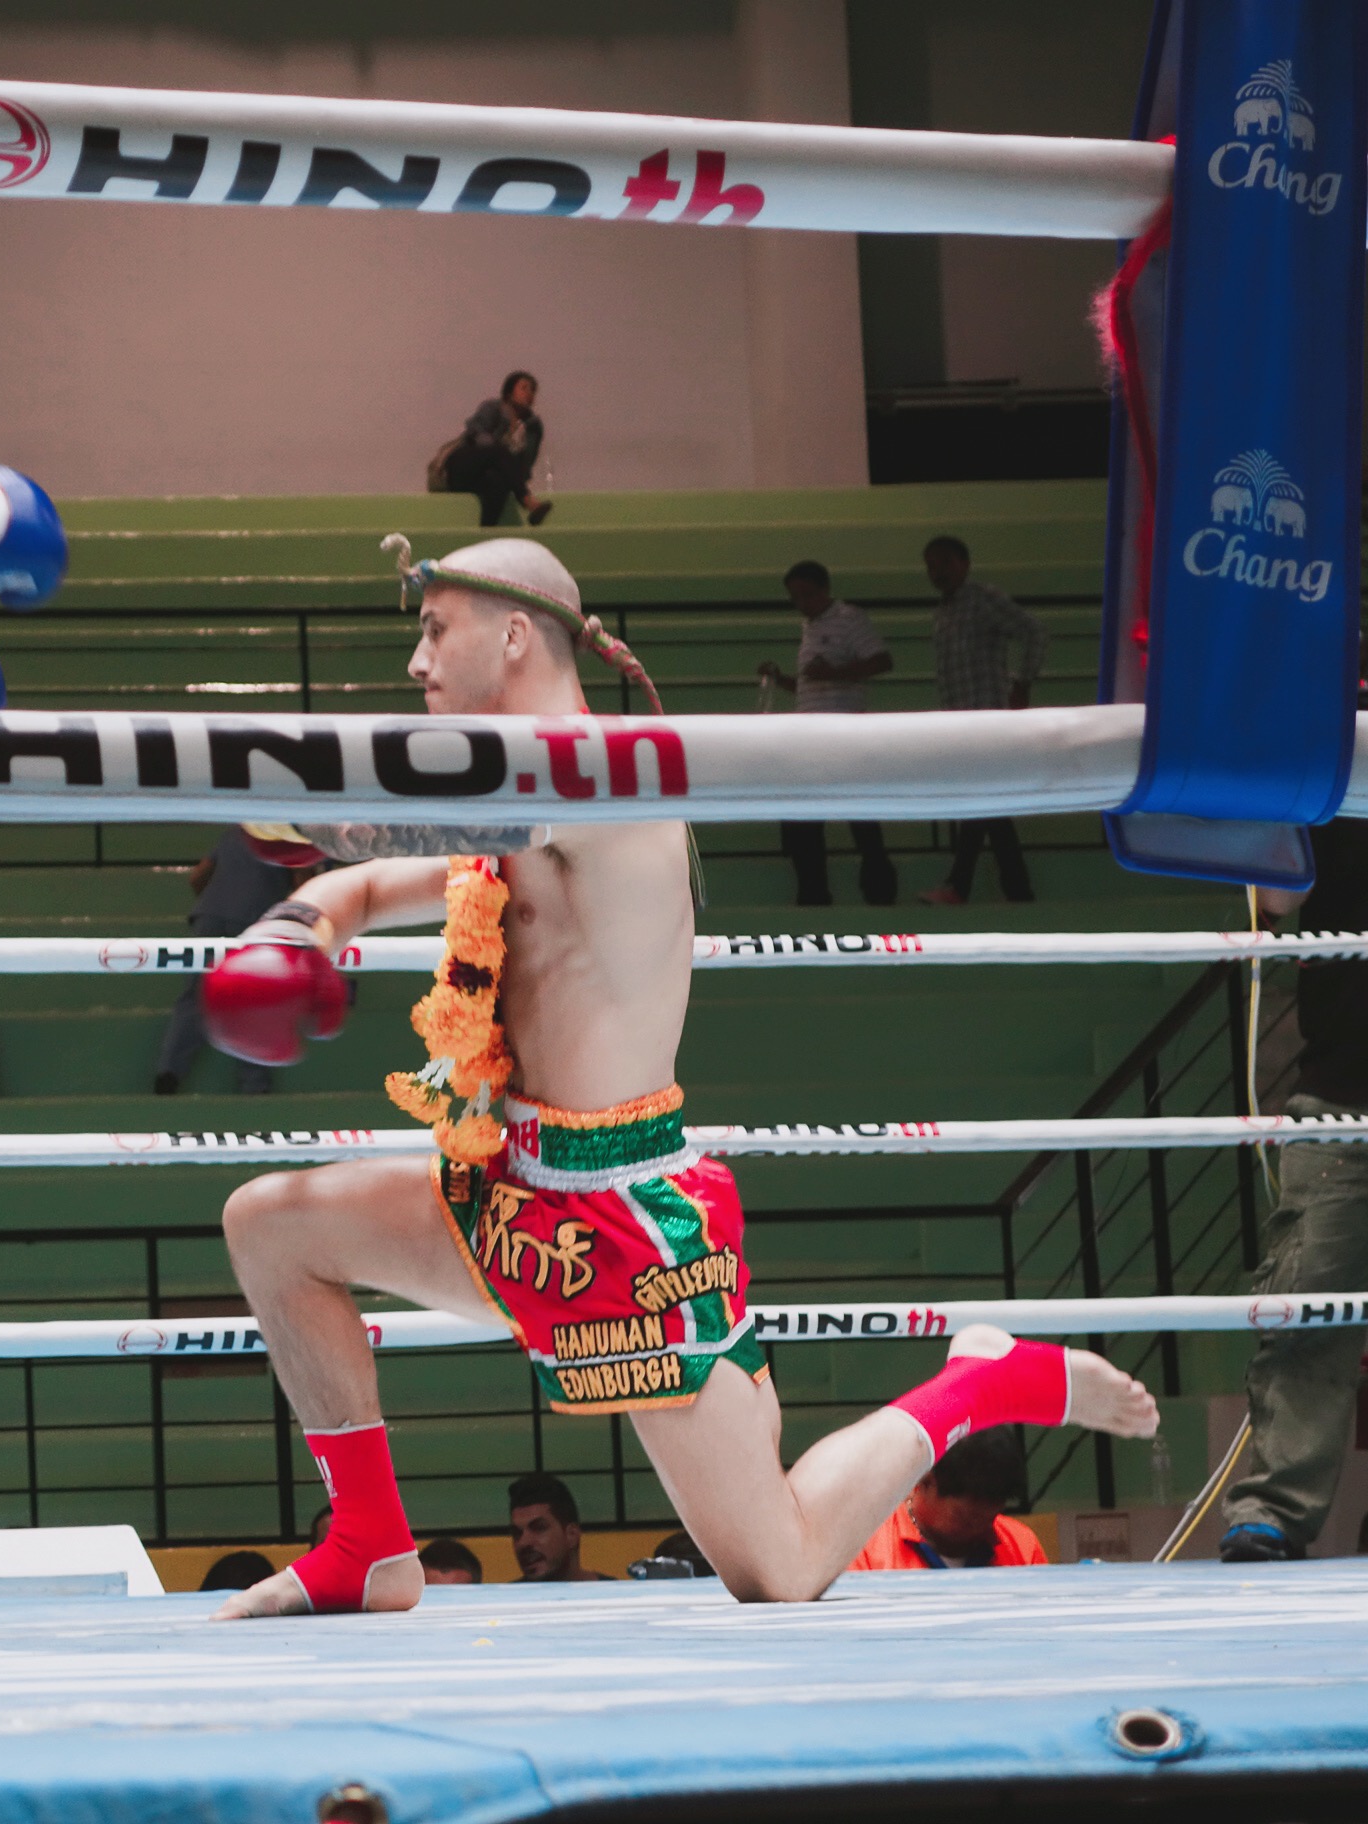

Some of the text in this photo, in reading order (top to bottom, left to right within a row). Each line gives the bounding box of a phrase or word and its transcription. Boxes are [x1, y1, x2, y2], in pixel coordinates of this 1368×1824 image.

[66, 126, 766, 226] HINOth
[1183, 527, 1332, 602] Chang
[554, 1315, 665, 1359] HANUMAN
[754, 1307, 948, 1337] HINO.th
[558, 1354, 681, 1400] EDINBURGH
